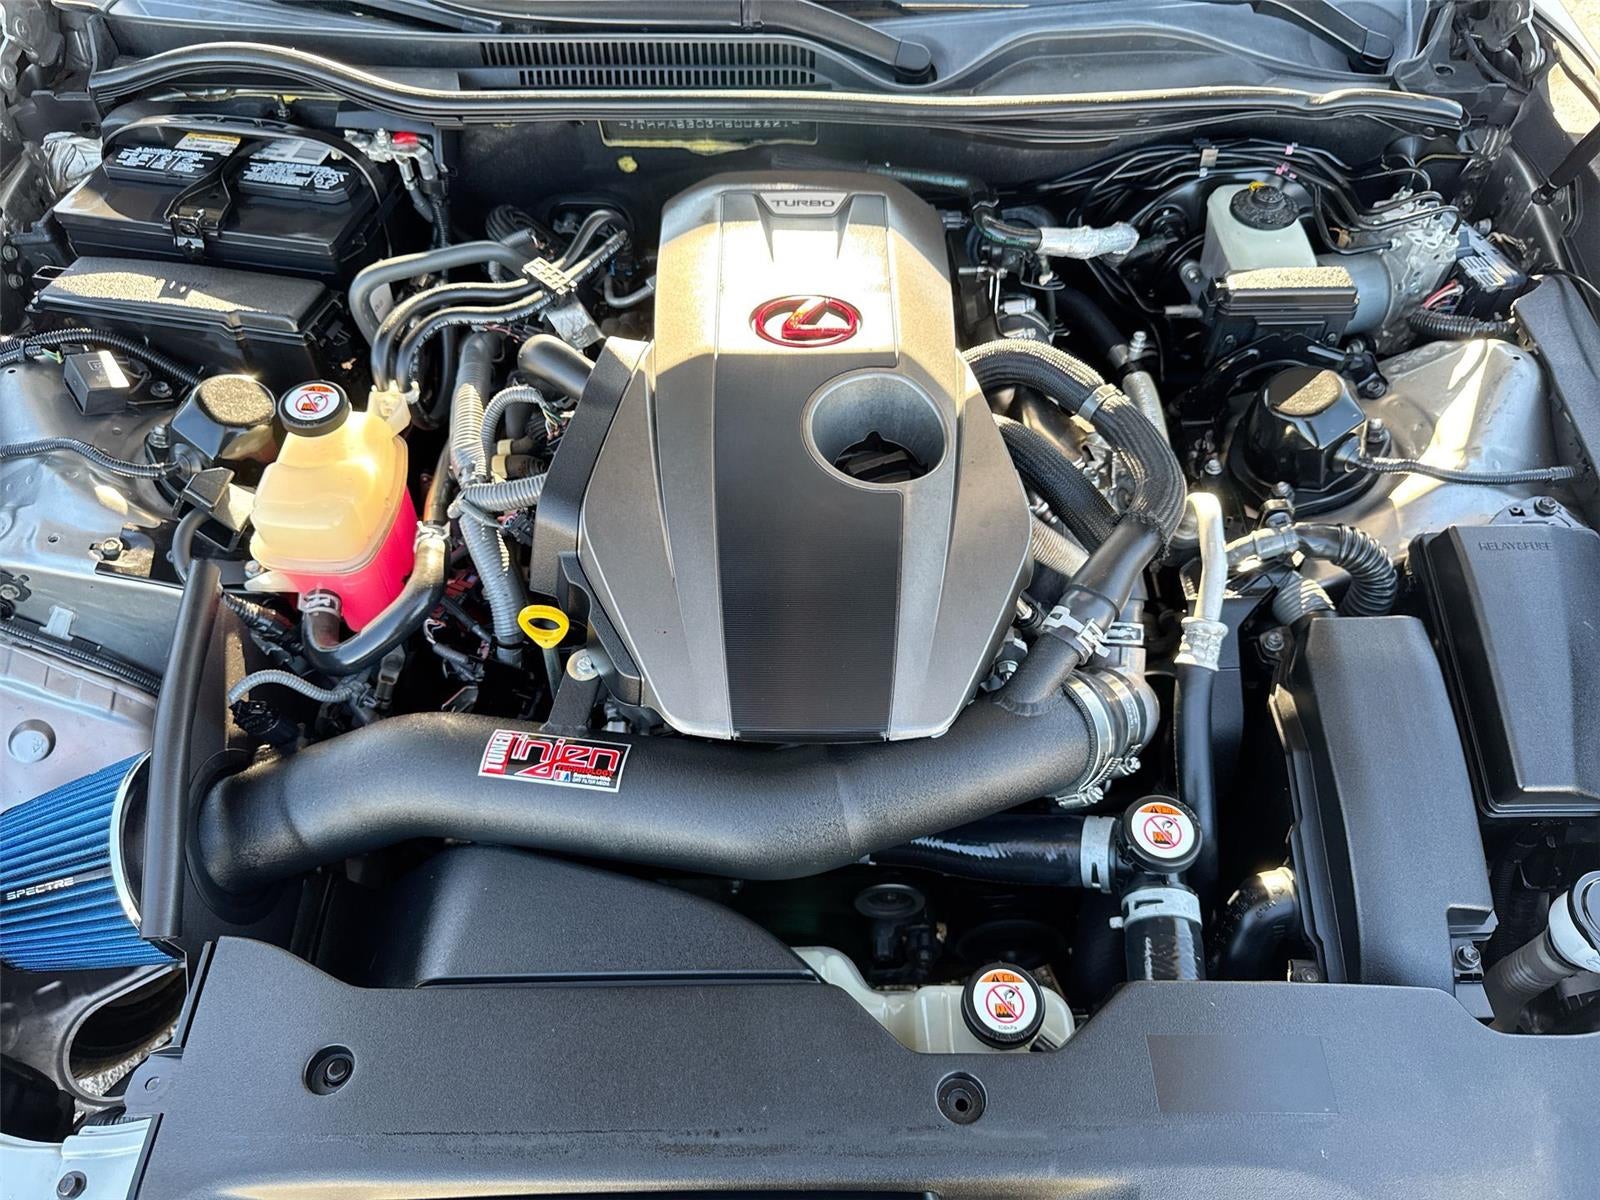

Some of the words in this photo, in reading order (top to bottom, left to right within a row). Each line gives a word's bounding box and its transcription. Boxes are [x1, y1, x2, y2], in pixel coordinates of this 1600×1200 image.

[771, 199, 835, 207] TURBO
[484, 733, 513, 770] TUNED
[6, 877, 74, 900] SPECTRE
